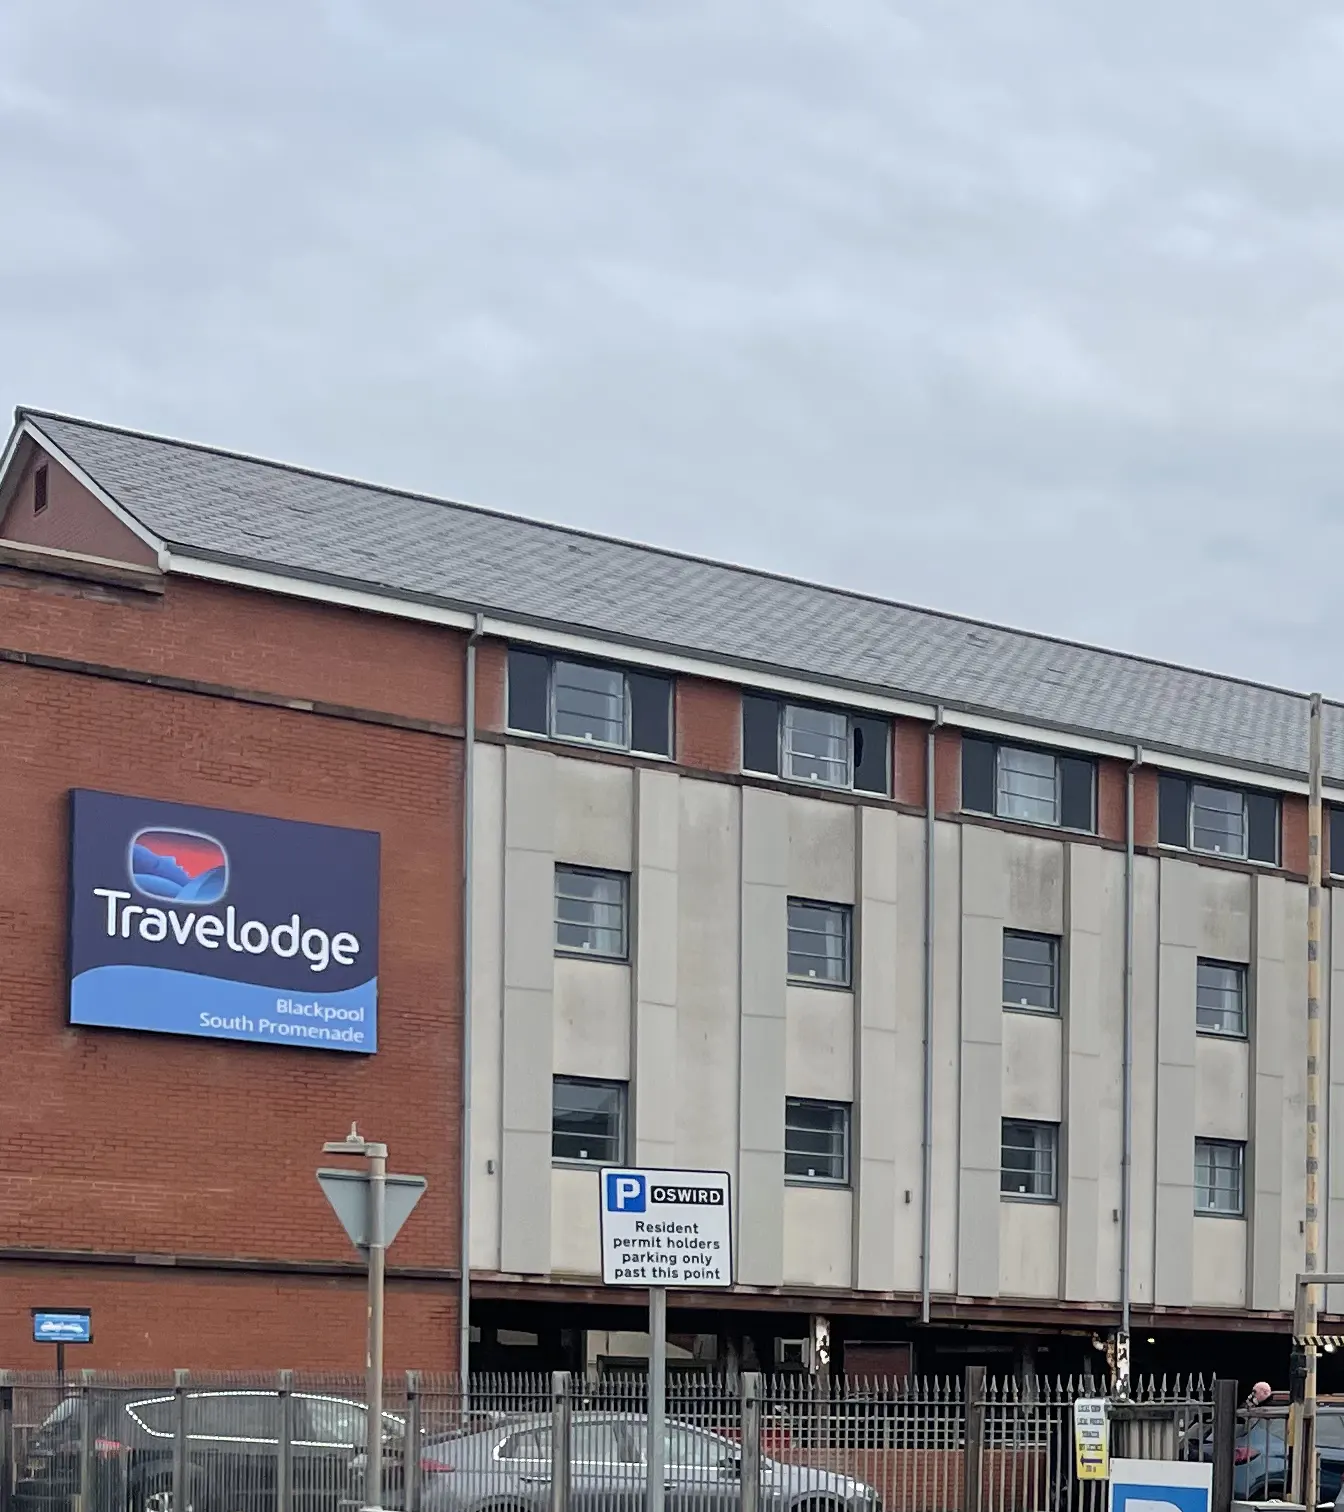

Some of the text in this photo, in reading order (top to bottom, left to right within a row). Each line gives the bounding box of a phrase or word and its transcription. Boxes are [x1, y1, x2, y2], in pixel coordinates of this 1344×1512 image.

[93, 888, 360, 972] Travelodge
[276, 998, 365, 1023] Blackpool
[199, 1012, 365, 1043] South Promenade
[653, 1188, 721, 1203] OSWIRD
[635, 1221, 699, 1234] Resident
[613, 1236, 720, 1249] permit holders
[622, 1252, 712, 1266] parking only
[615, 1267, 721, 1280] past this point
